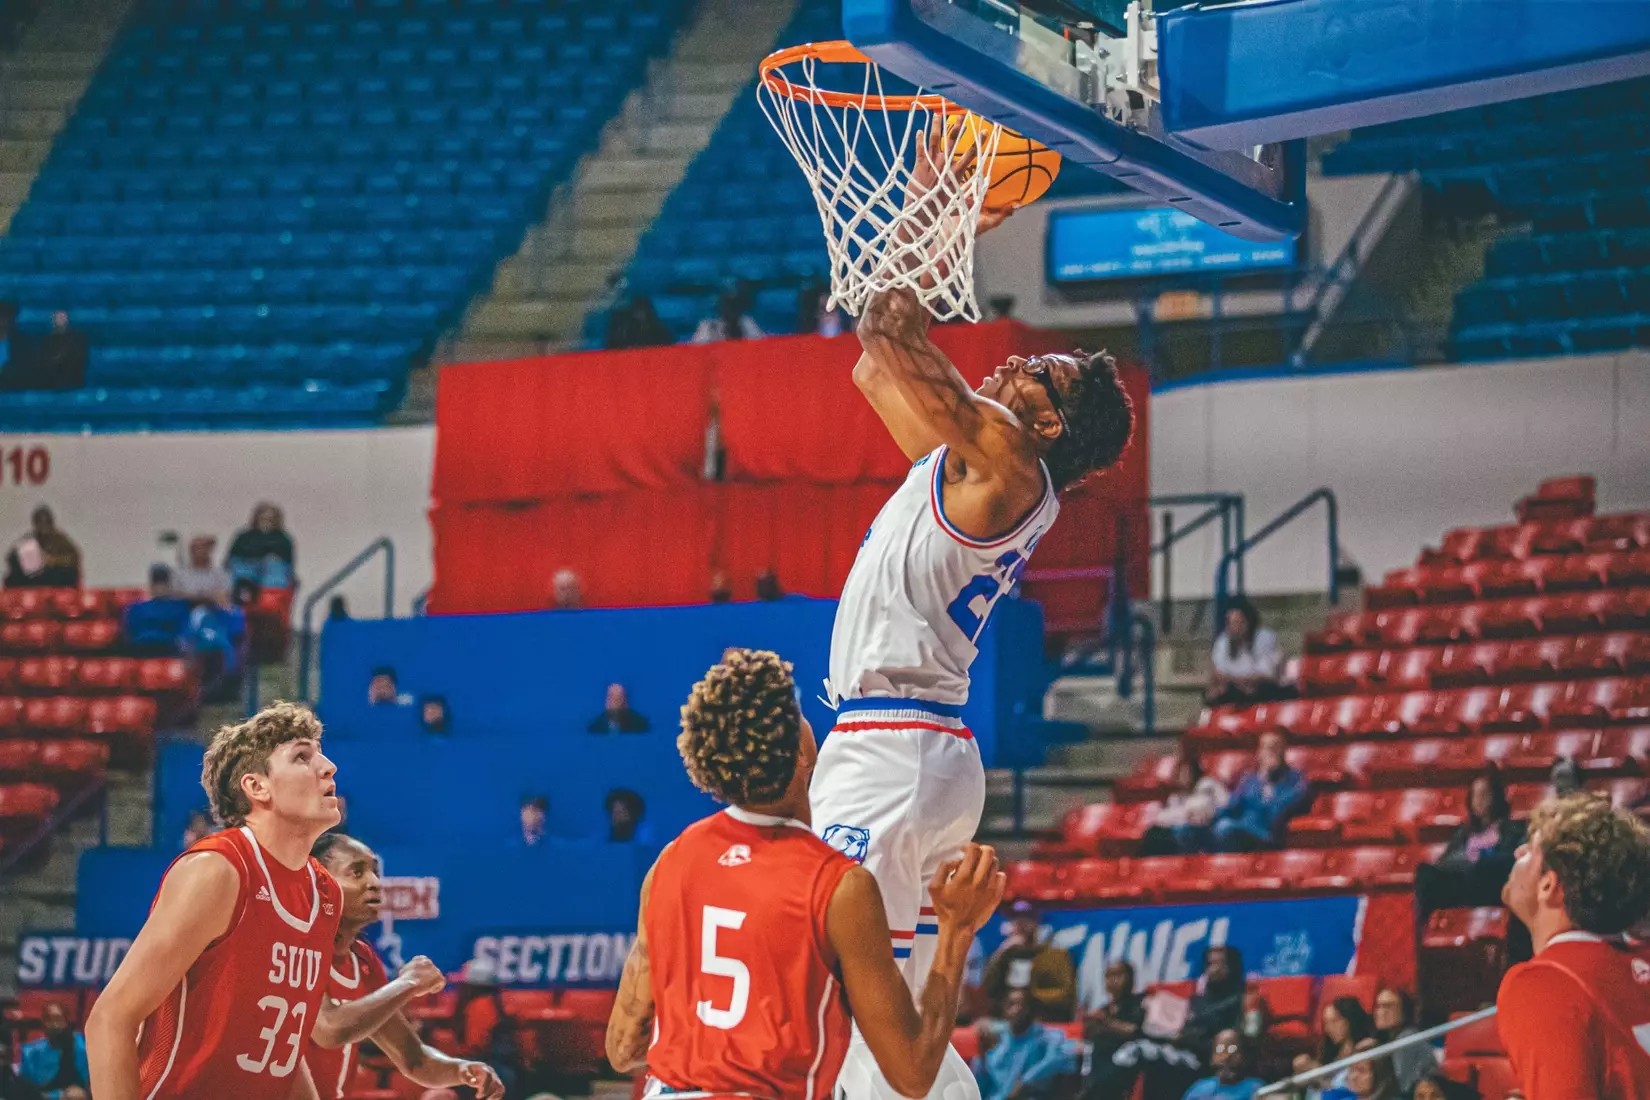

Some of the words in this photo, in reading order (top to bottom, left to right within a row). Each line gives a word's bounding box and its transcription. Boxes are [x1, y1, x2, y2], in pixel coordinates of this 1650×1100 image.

[268, 942, 322, 991] SUU
[696, 904, 750, 1030] 5
[236, 995, 307, 1078] 33
